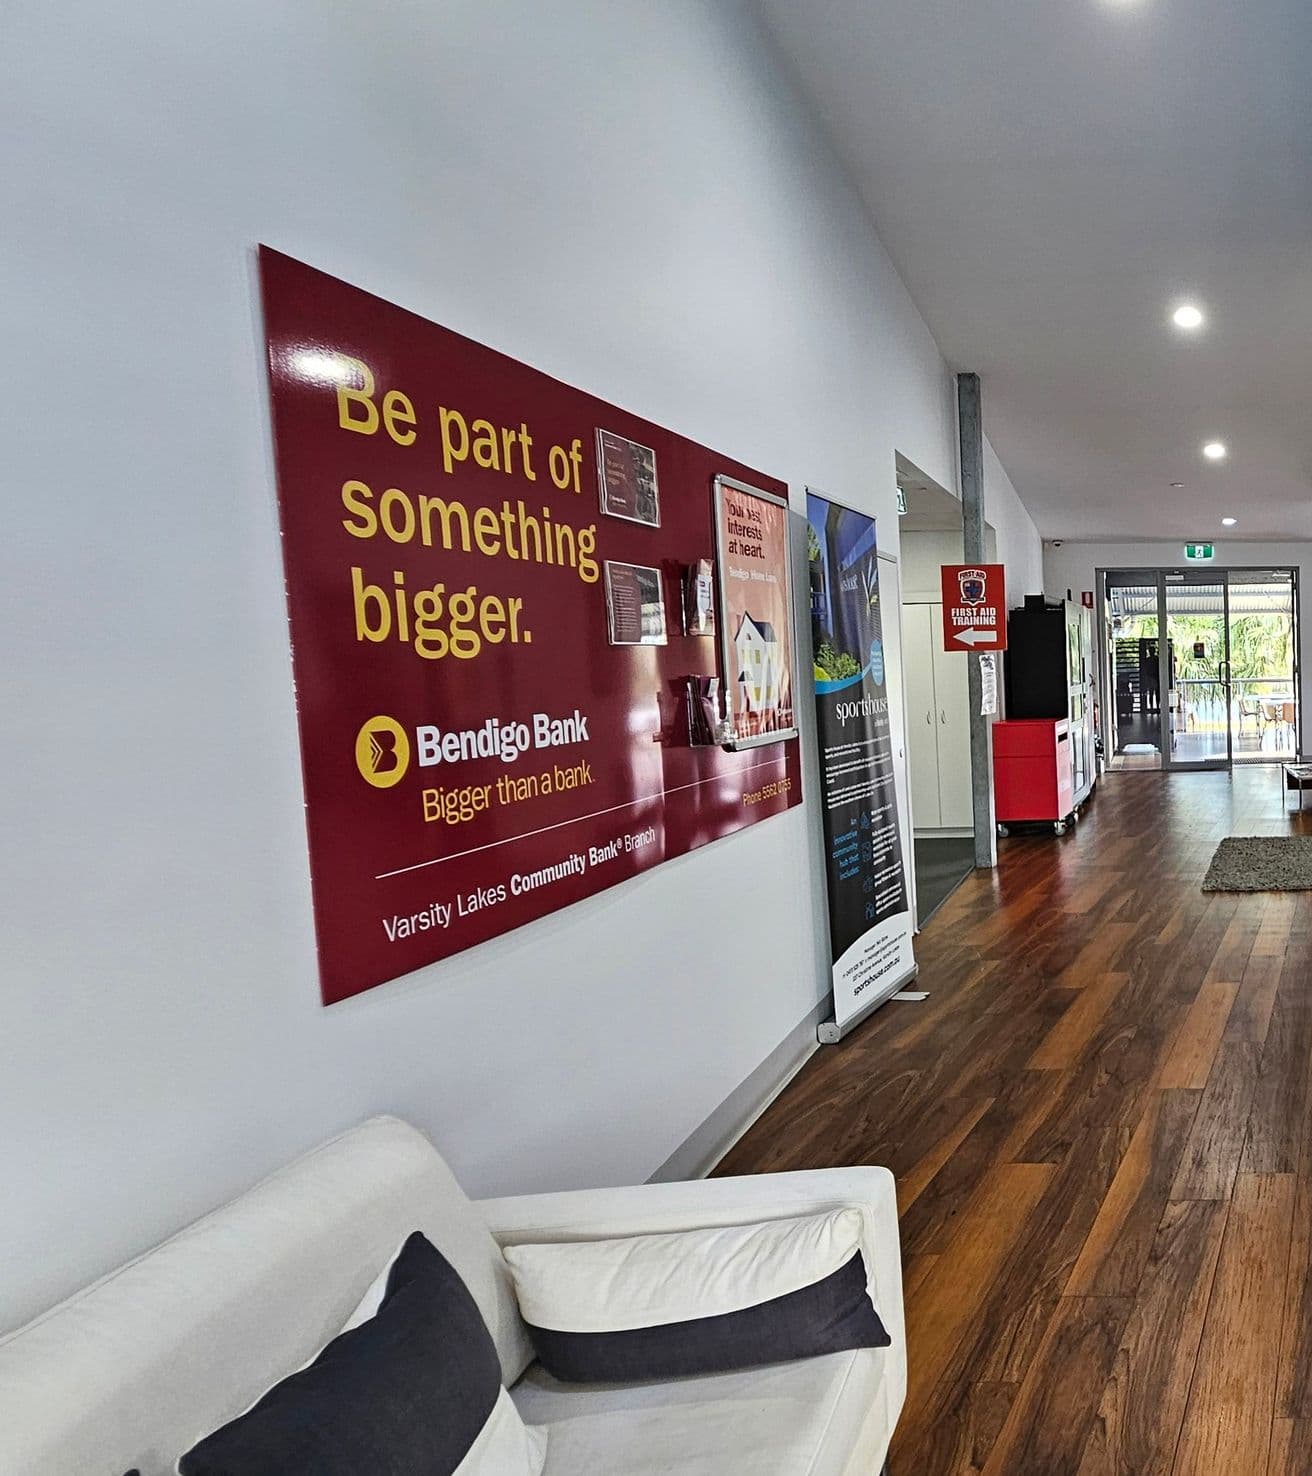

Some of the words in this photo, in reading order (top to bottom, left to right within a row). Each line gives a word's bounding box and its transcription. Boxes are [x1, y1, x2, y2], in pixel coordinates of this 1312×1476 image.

[336, 353, 417, 446] Be
[439, 406, 536, 480] part
[548, 439, 582, 493] of
[726, 498, 744, 518] Your
[342, 480, 600, 583] something
[728, 517, 763, 540] interests
[729, 539, 738, 555] at
[351, 567, 533, 660] bigger.
[951, 608, 977, 617] FIRST
[980, 608, 997, 616] AID
[952, 616, 997, 626] TRAINING
[416, 718, 530, 767] Bendigo
[533, 710, 590, 749] Bank
[422, 784, 492, 825] Bigger
[496, 774, 539, 806] than
[541, 773, 552, 795] a
[554, 760, 596, 792] bank.
[743, 789, 762, 807] Phone
[382, 903, 452, 942] Varsity
[457, 884, 507, 917] Lakes
[510, 854, 586, 896] Community
[625, 826, 656, 852] Branch
